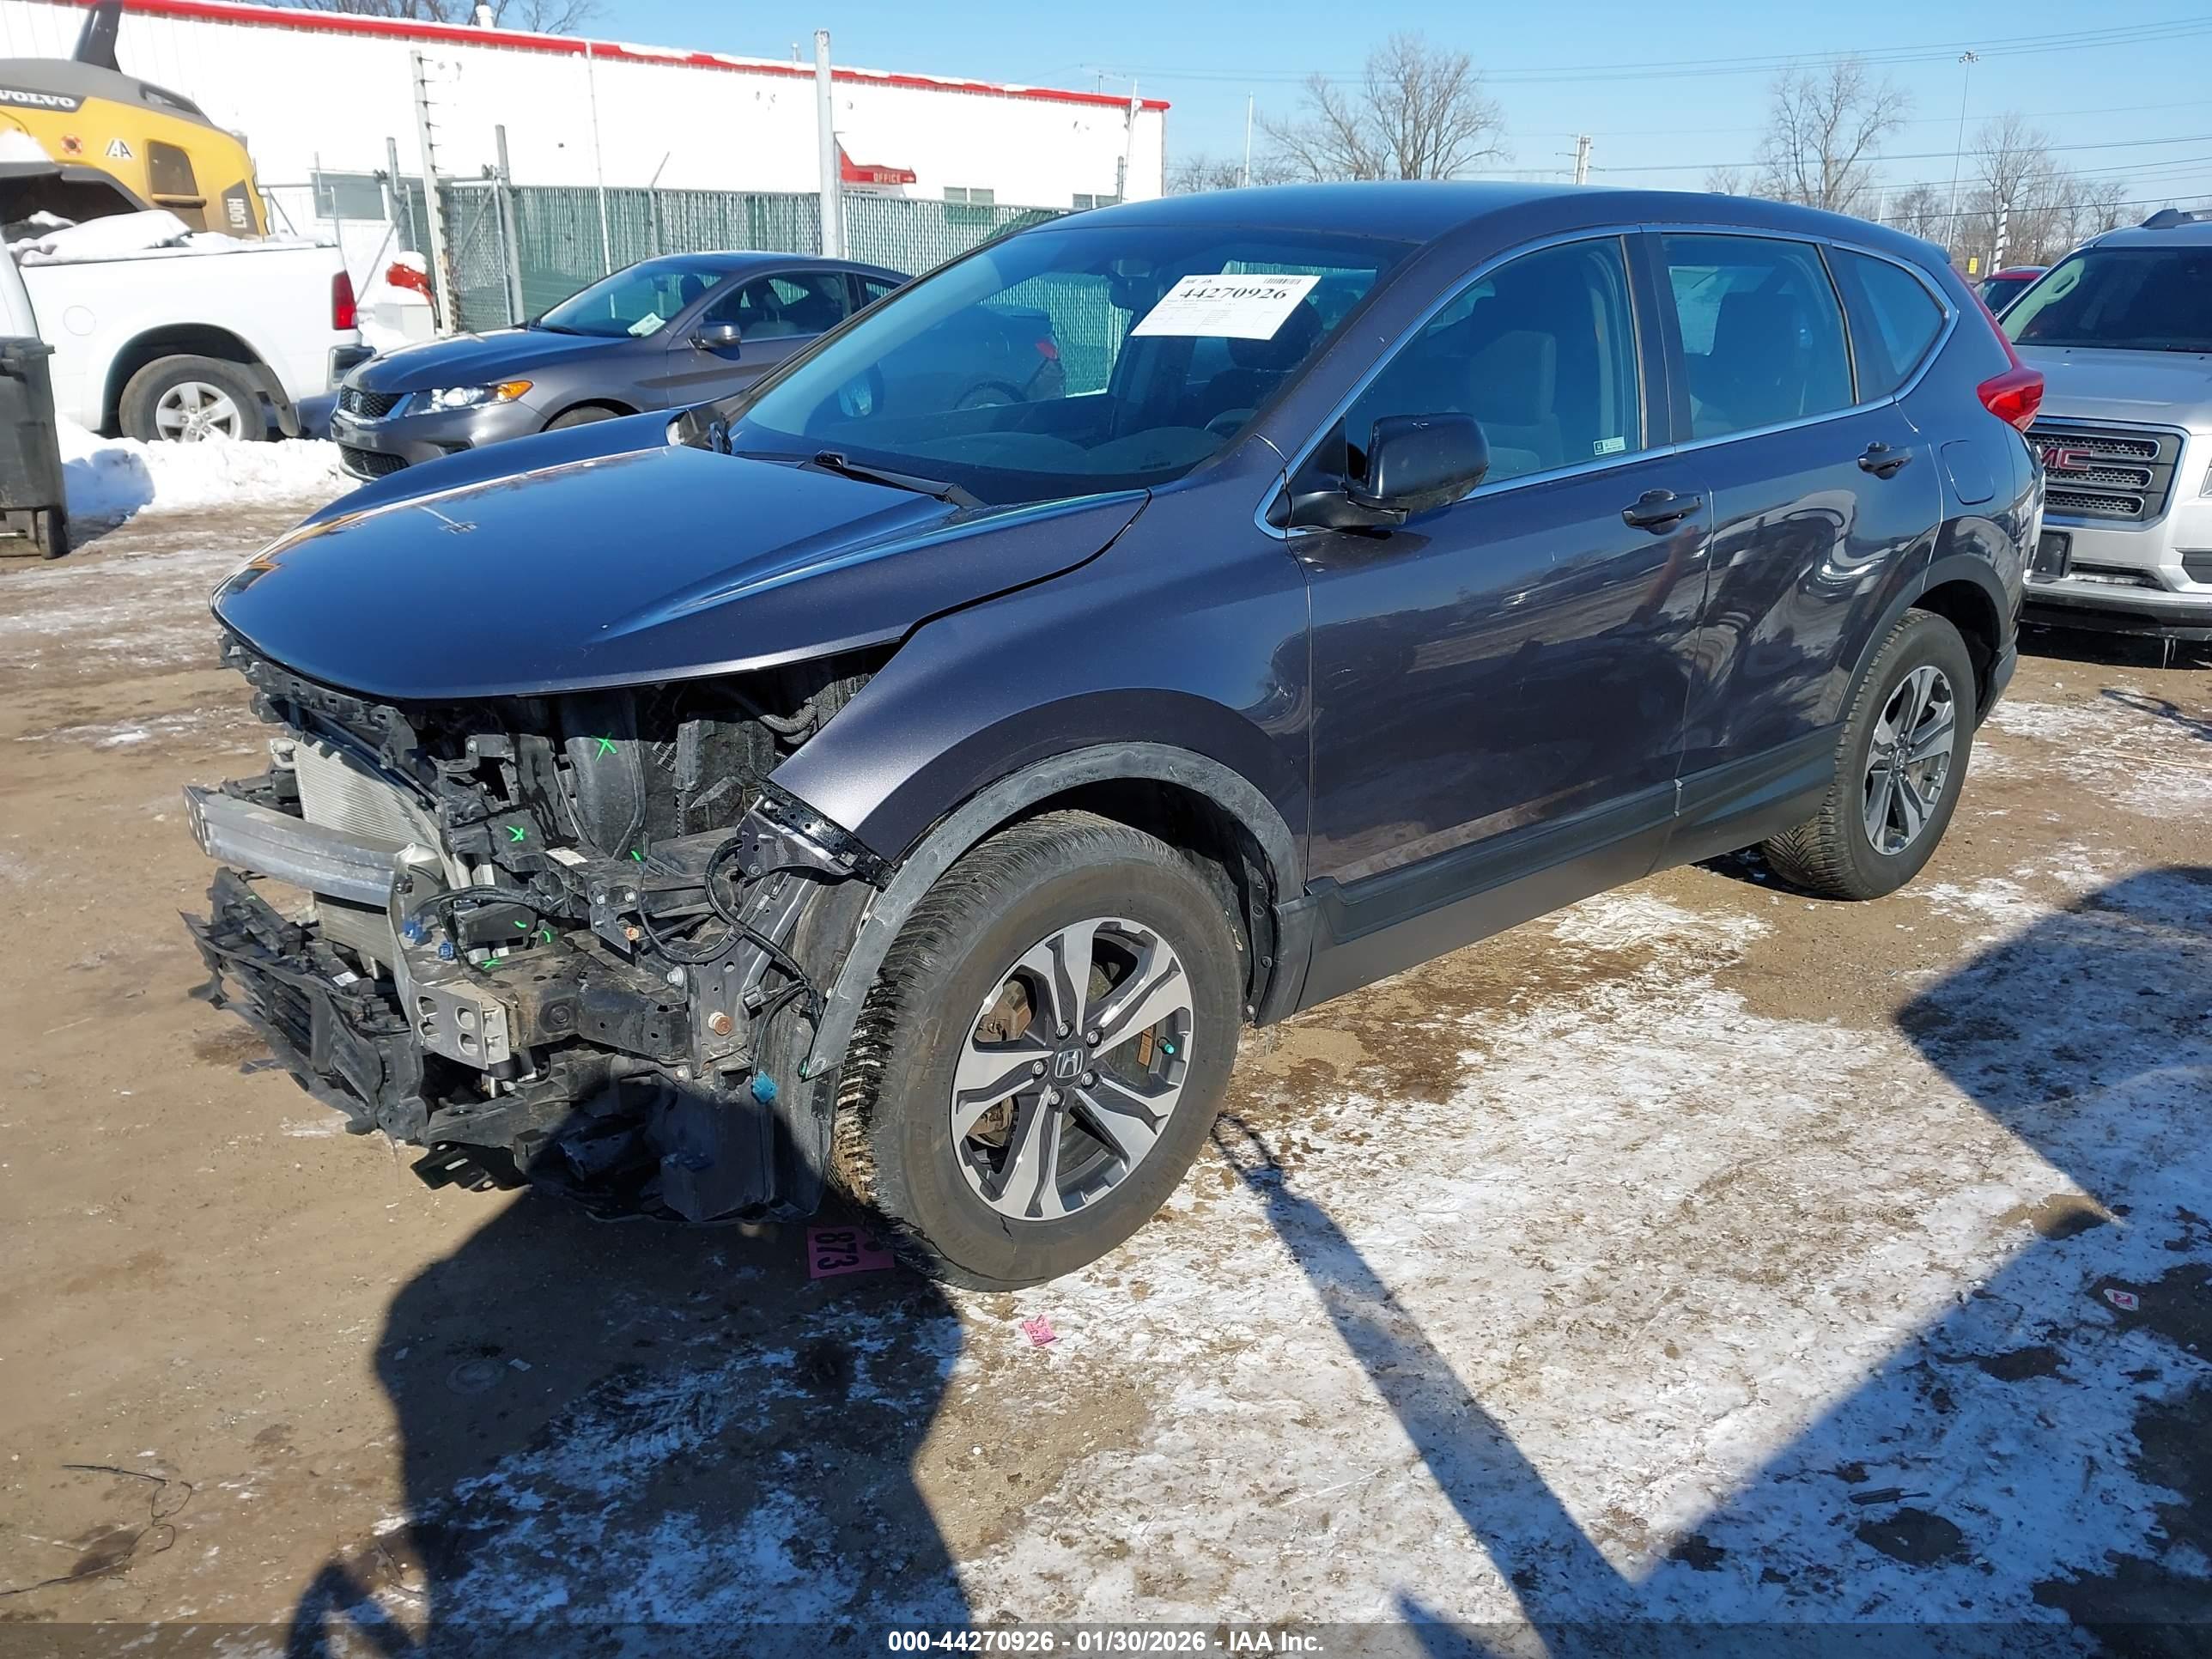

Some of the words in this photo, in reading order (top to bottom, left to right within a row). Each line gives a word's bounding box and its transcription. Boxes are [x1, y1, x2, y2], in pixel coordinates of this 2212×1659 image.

[0, 89, 76, 108] VOLVO
[873, 172, 901, 184] OFFICE
[227, 198, 247, 228] L90H
[1179, 288, 1289, 300] 44270926
[815, 1231, 860, 1270] 873
